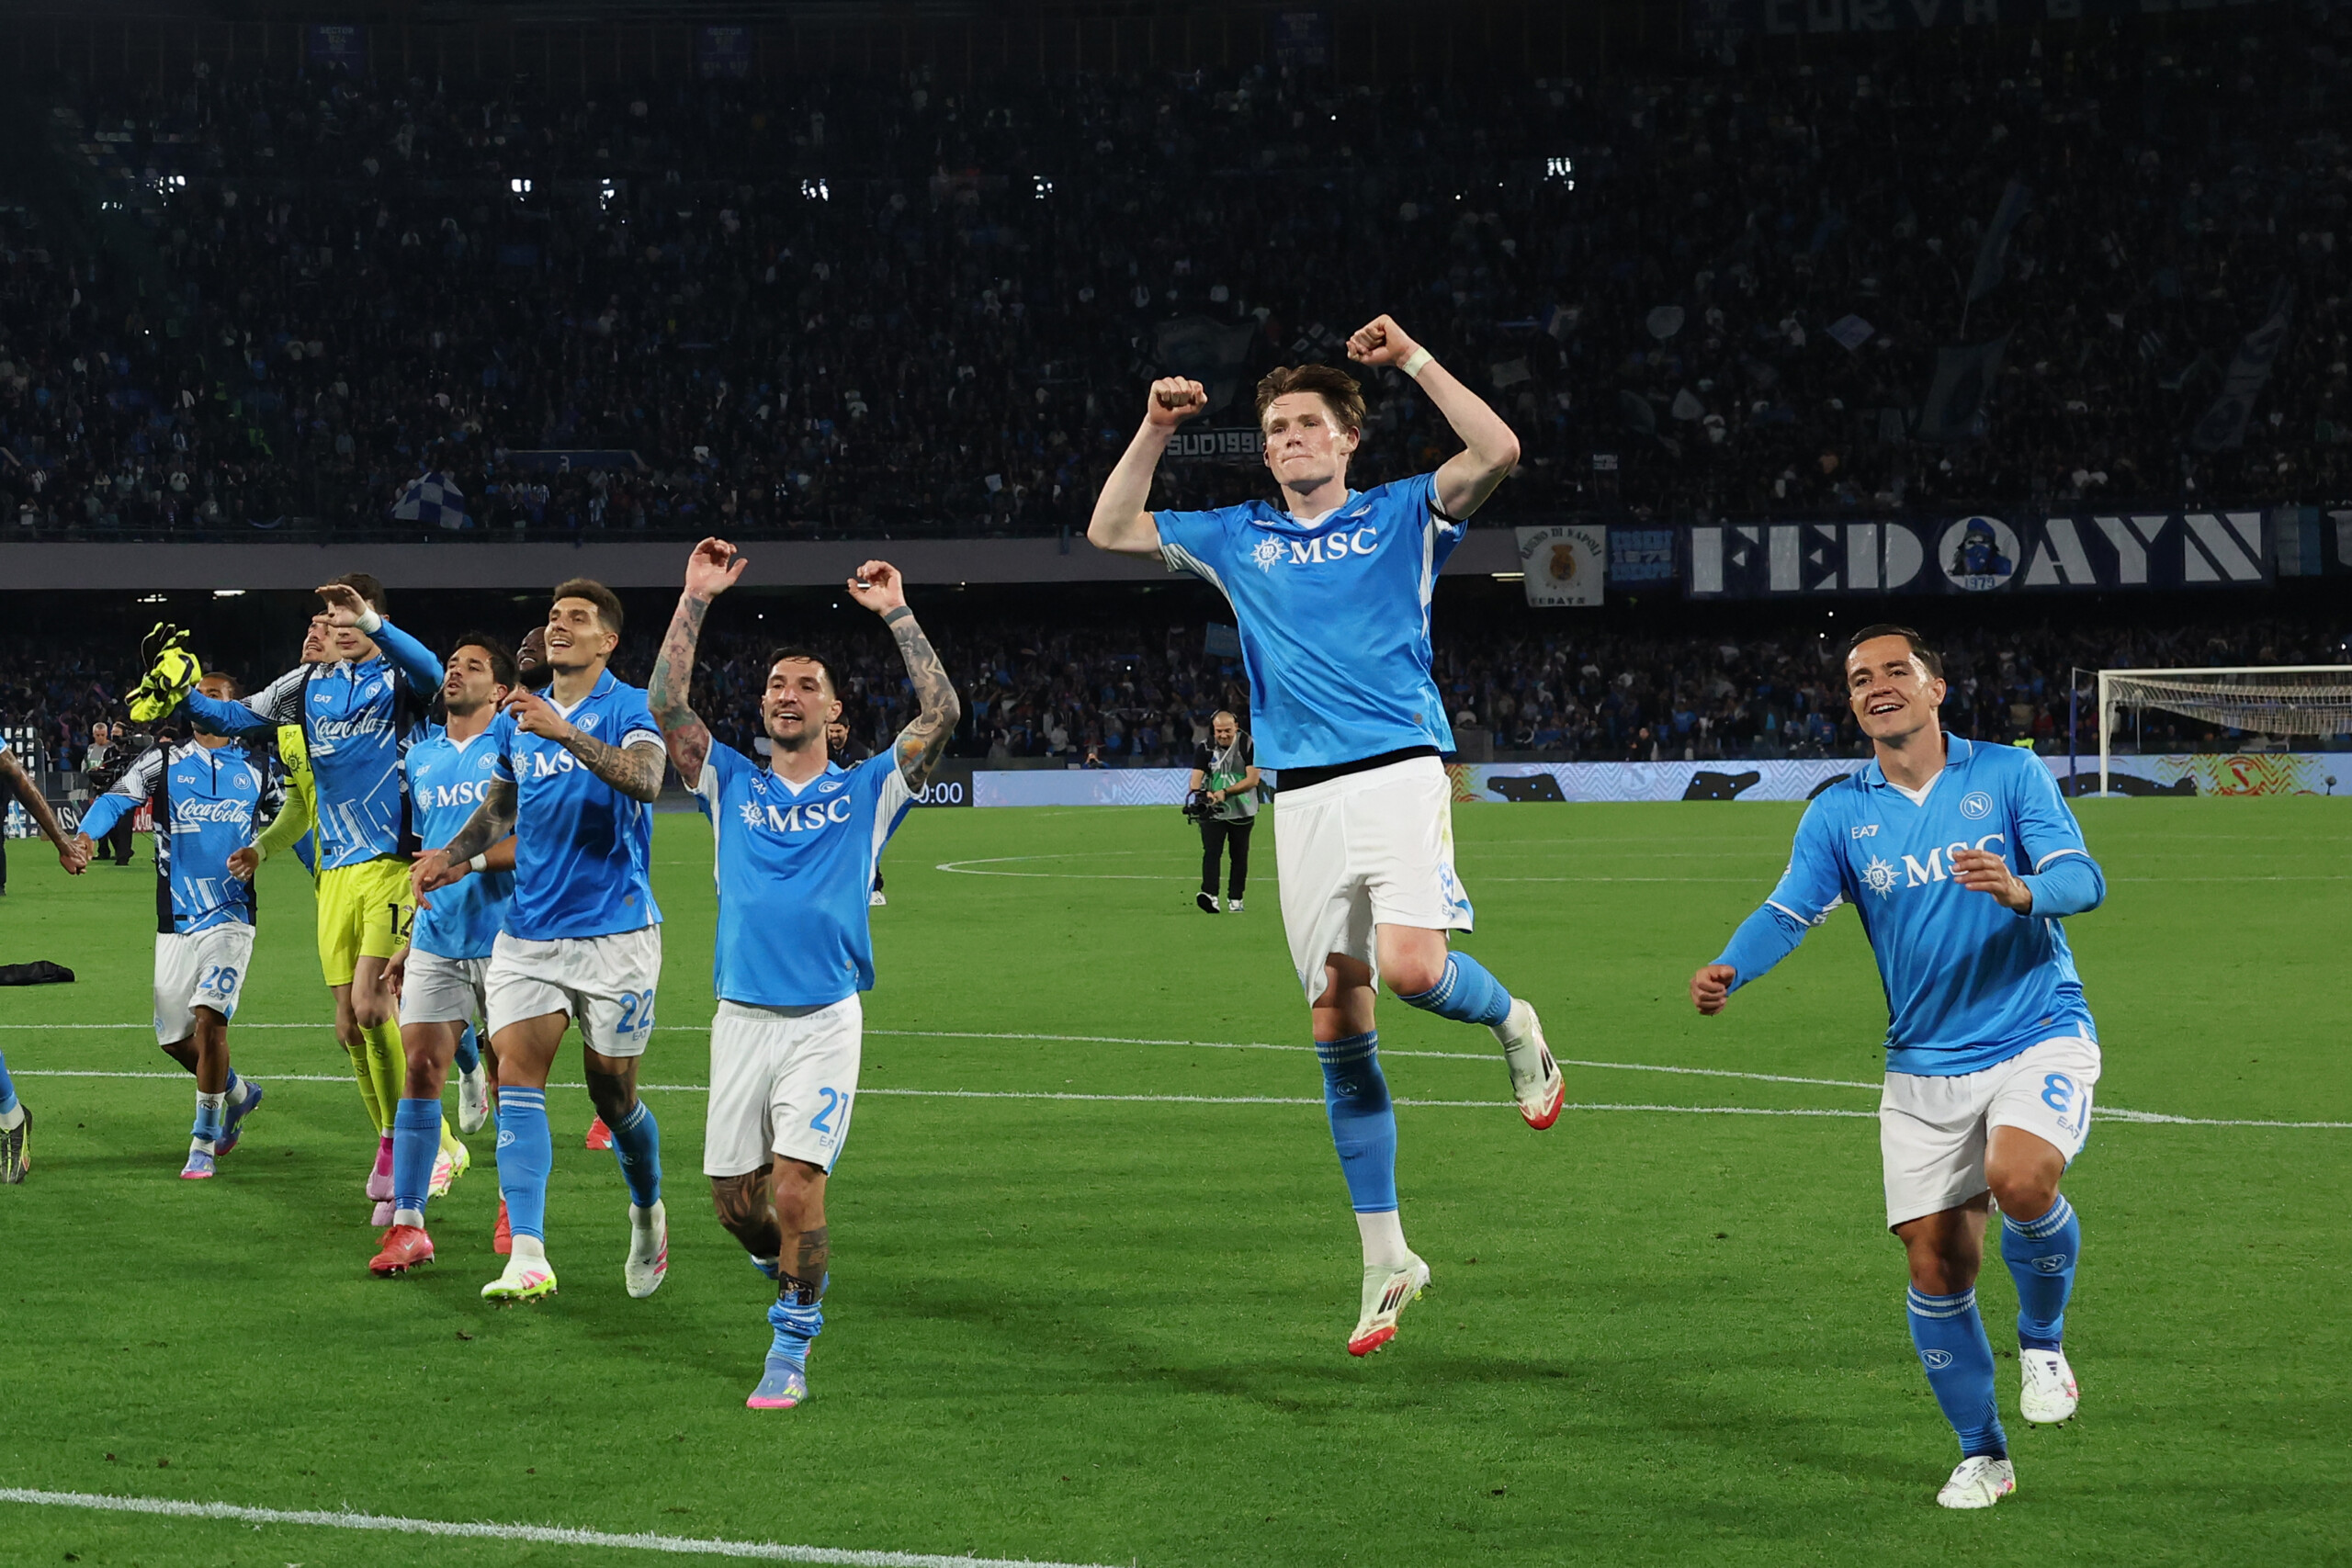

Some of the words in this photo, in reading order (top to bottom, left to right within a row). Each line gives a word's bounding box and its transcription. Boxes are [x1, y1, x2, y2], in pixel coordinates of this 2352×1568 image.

[1551, 527, 1563, 537] DI
[1287, 526, 1379, 565] MSC
[1963, 575, 1996, 590] 1979
[313, 694, 333, 704] EA7
[176, 774, 196, 785] EA7
[436, 779, 492, 808] MSC
[766, 794, 851, 833] MSC
[1850, 824, 1880, 840] EA7
[334, 844, 345, 857] 12
[388, 903, 413, 936] 12
[199, 965, 239, 994] 26
[208, 990, 226, 1000] EA7
[616, 988, 653, 1034] 22
[632, 1029, 648, 1042] EA7
[809, 1087, 850, 1138] 21
[2056, 1115, 2081, 1140] EA7
